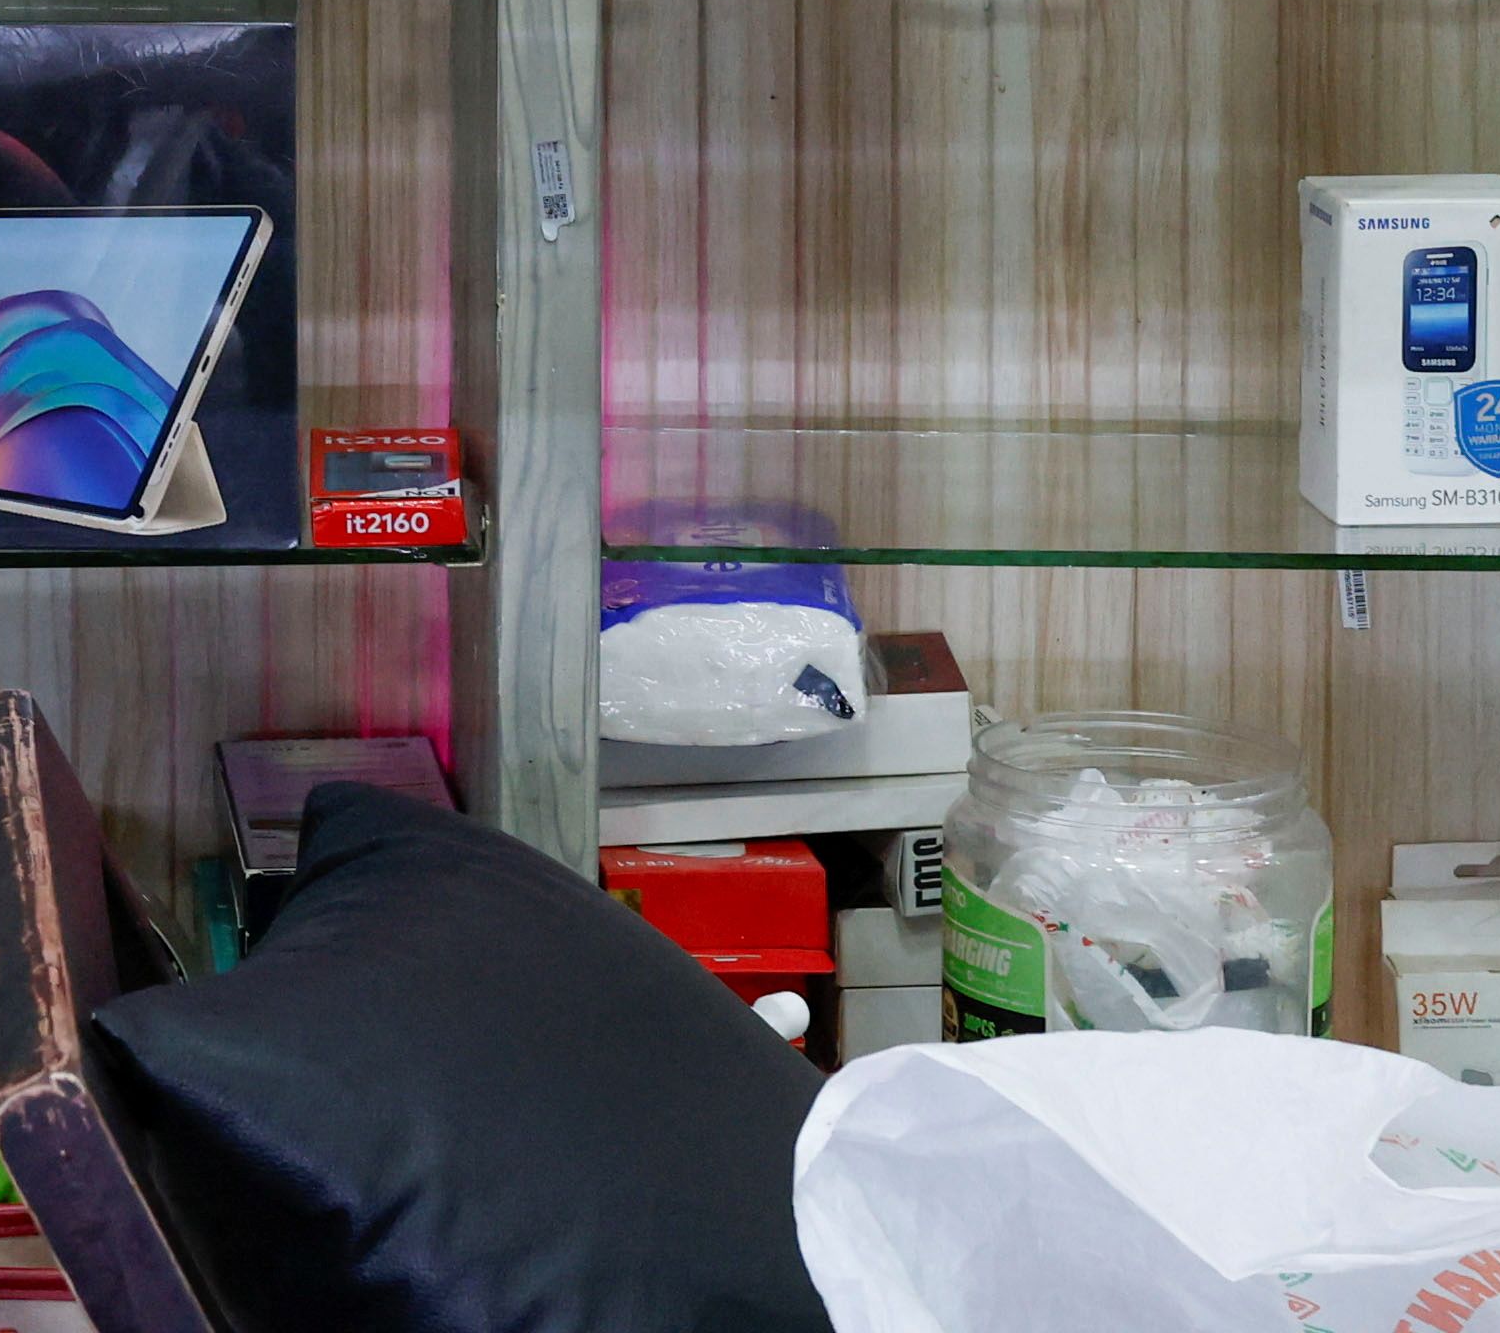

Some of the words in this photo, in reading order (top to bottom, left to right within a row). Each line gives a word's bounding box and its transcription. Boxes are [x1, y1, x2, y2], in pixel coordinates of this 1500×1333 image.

[1358, 217, 1430, 231] SAMSUNG
[324, 437, 446, 445] it2160
[1364, 493, 1426, 511] Samsung
[346, 513, 430, 533] it2160
[1412, 991, 1478, 1016] 35W
